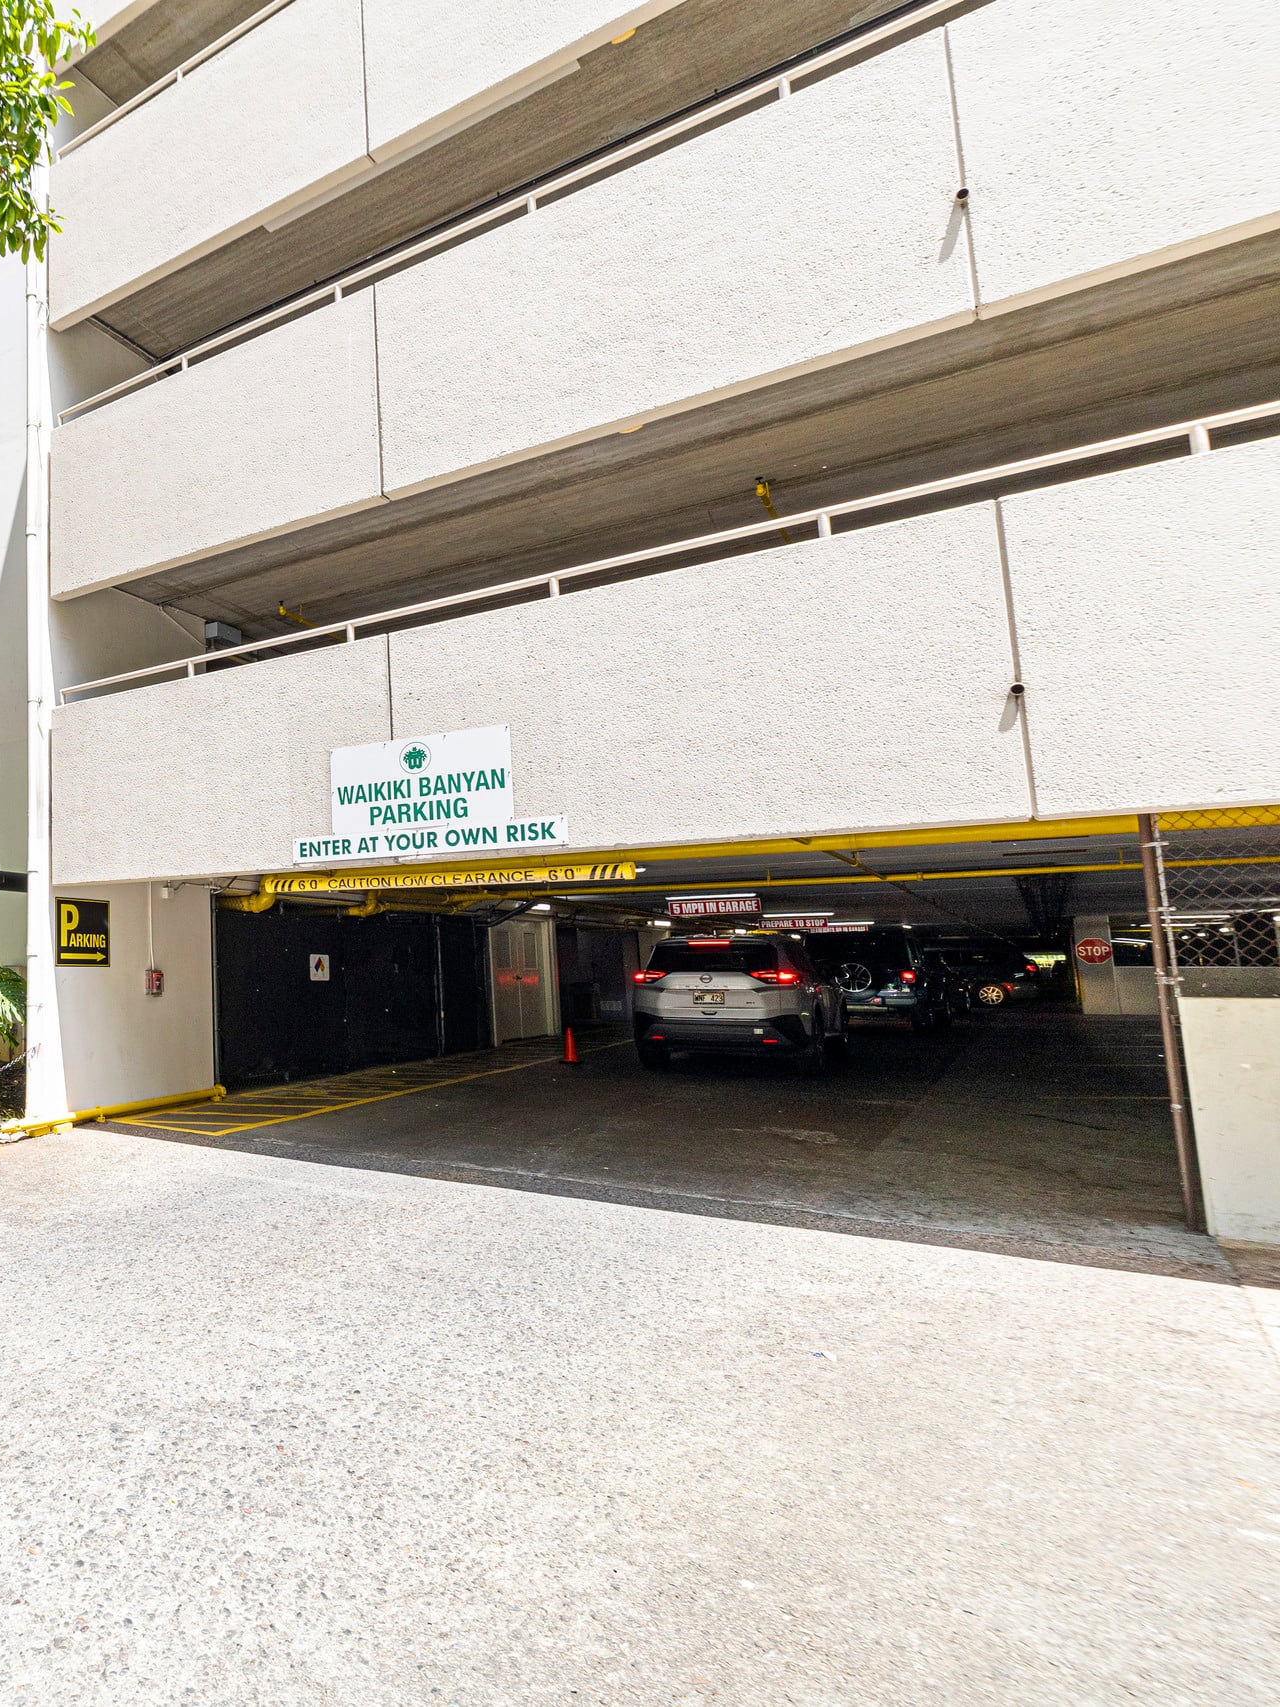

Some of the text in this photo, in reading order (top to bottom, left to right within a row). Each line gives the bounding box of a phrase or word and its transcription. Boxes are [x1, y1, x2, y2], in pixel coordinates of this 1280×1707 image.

[337, 767, 506, 806] WAIKIKI BANYAN
[370, 797, 468, 826] PARKING
[299, 821, 556, 858] ENTER AT YOUR OWN RISK
[327, 877, 391, 889] CAUTION
[394, 875, 429, 887] LOW
[431, 870, 536, 886] CLEARANCE
[672, 900, 759, 914] 5 MPH IN GARAGE
[761, 919, 825, 928] PREPARE TO STOP
[1078, 946, 1110, 956] STOP
